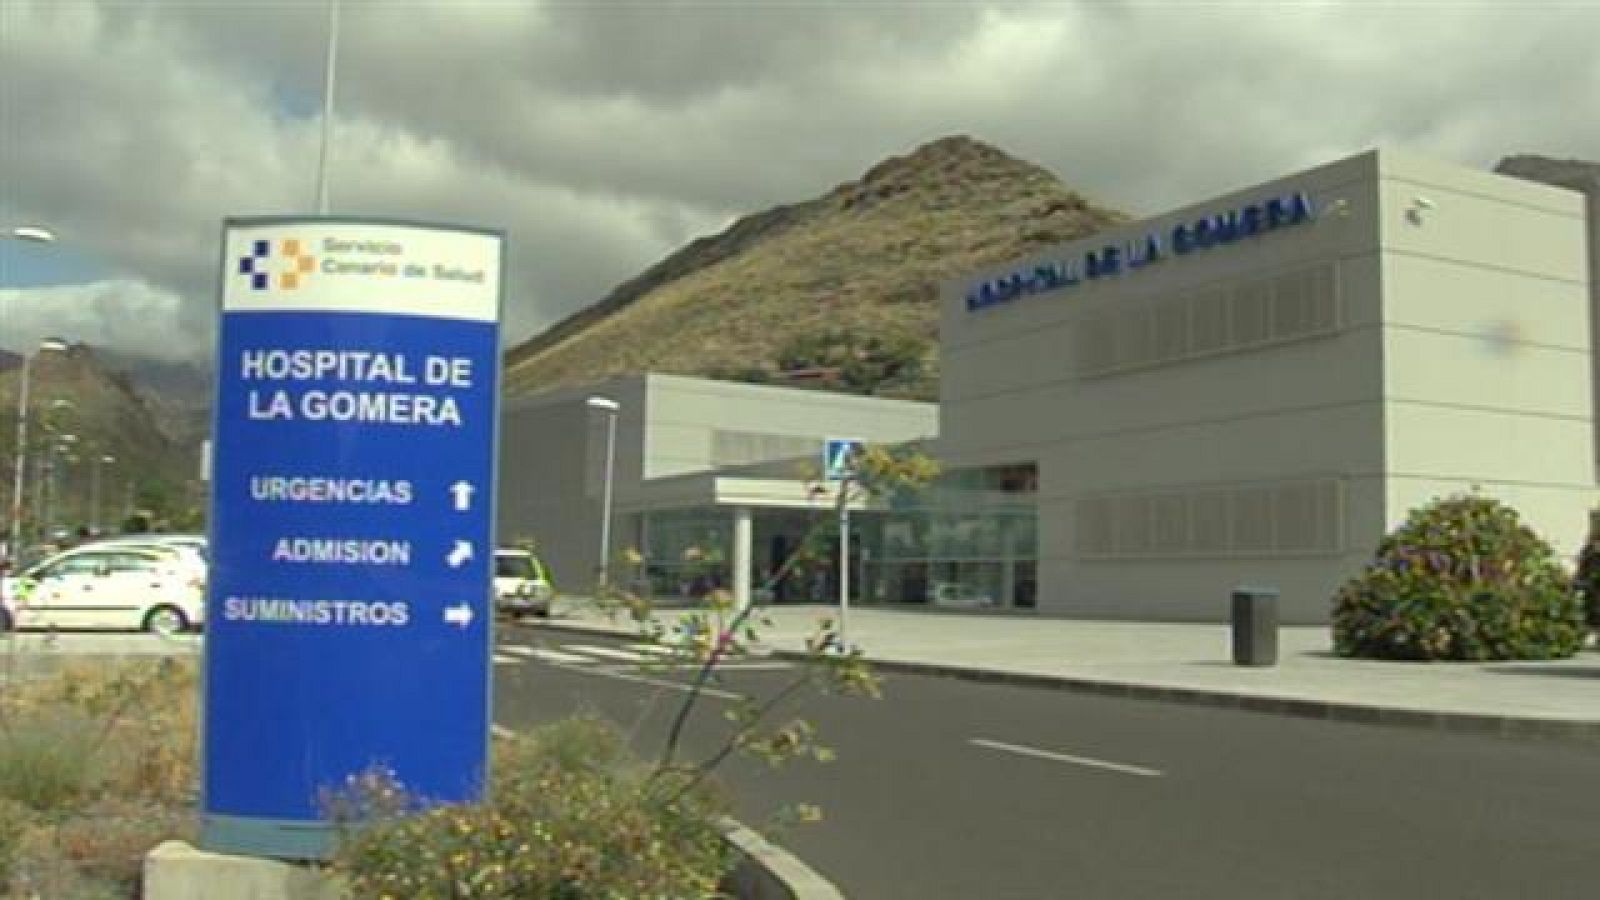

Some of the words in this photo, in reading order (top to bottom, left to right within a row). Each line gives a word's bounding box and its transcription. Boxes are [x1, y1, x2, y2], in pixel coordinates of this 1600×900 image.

[321, 259, 397, 275] Canario
[404, 264, 426, 277] de
[432, 264, 485, 283] Salud
[241, 350, 416, 383] HOSPITAL
[424, 356, 473, 388] DE
[249, 390, 293, 420] LA
[301, 391, 461, 426] GOMERA
[250, 476, 413, 504] URGENCIAS
[272, 538, 411, 565] ADMISION
[223, 596, 410, 626] SUMINISTROS
